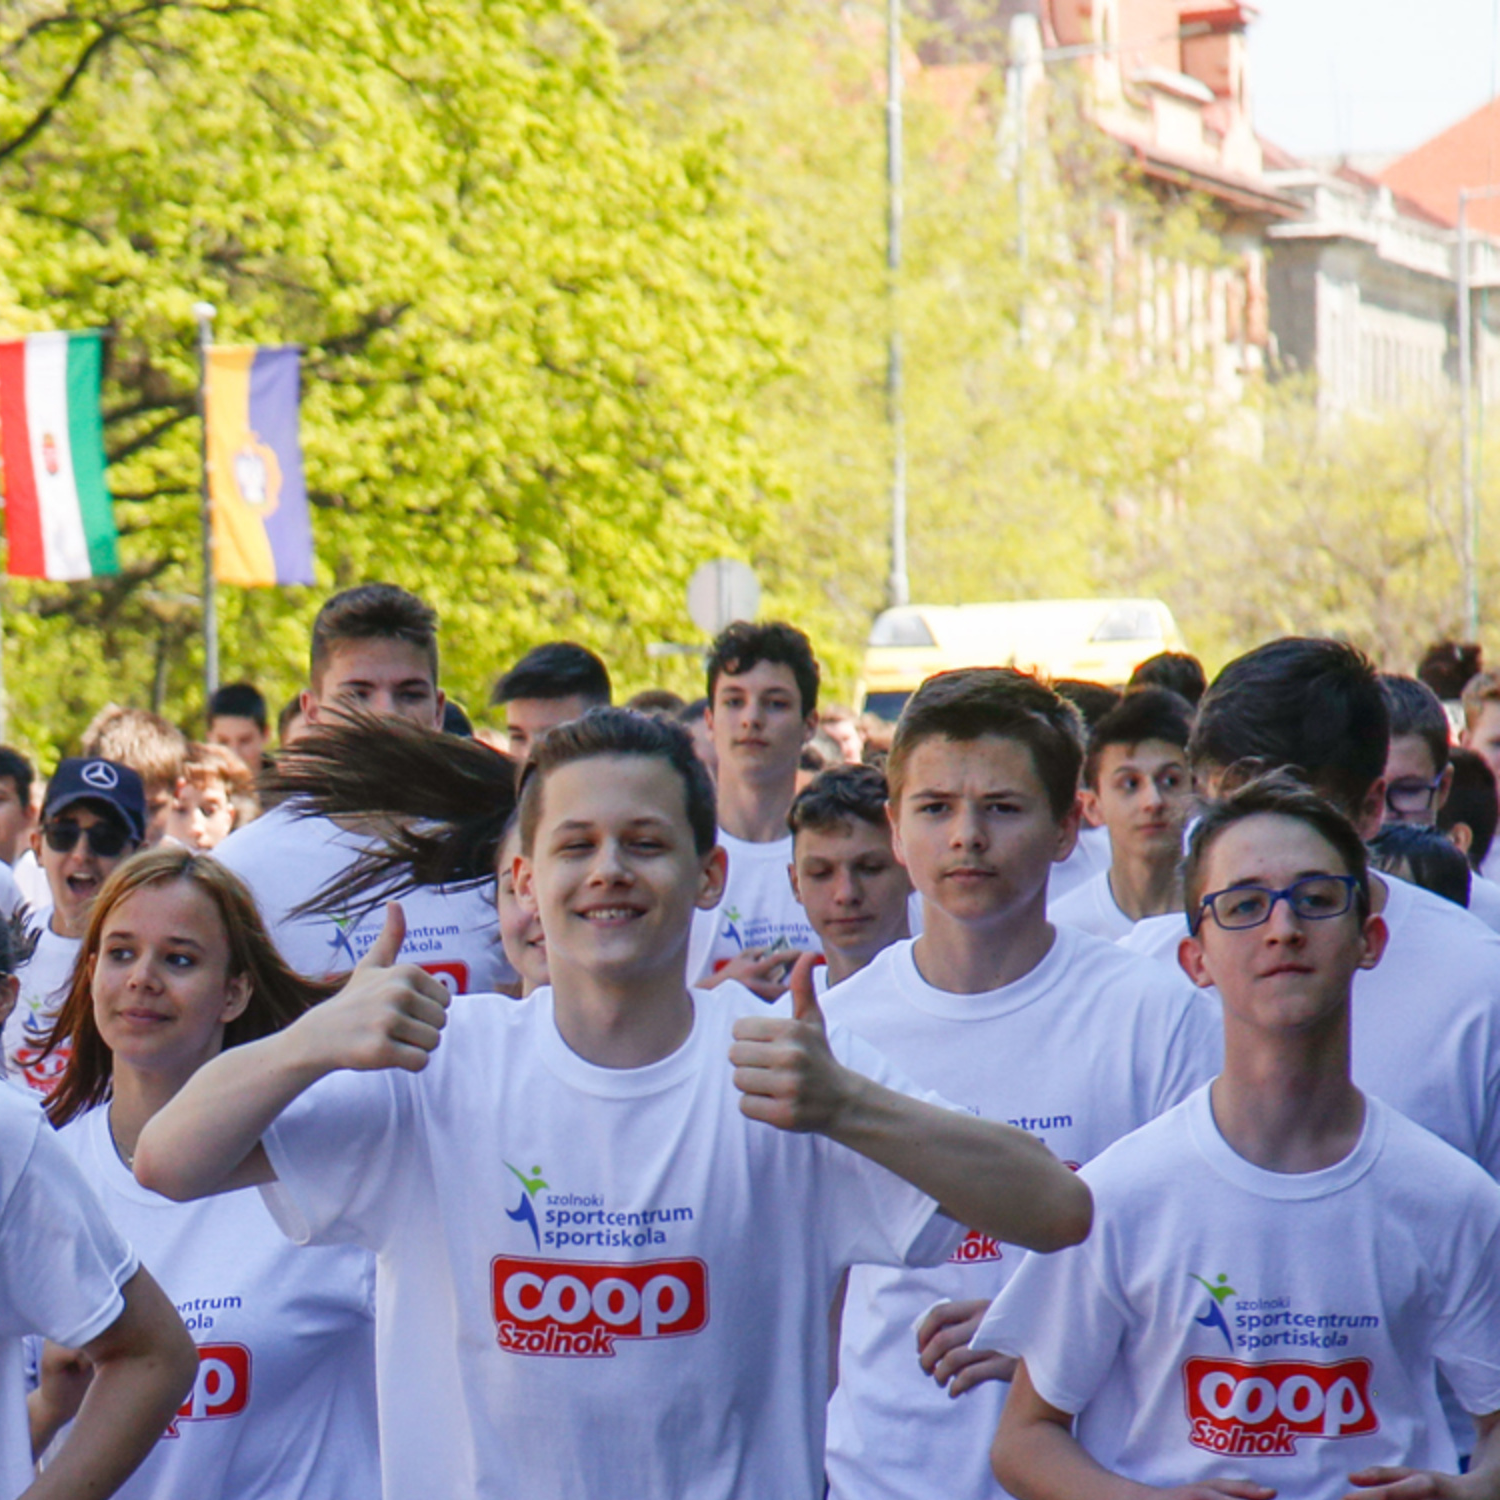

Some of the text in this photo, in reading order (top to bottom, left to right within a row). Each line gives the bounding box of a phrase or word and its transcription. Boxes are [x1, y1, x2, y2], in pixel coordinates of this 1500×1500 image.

[546, 1193, 604, 1208] szolnoki
[545, 1206, 694, 1228] sportcentrum
[543, 1227, 667, 1249] sportiskola
[503, 1271, 690, 1336] coop
[1235, 1296, 1291, 1311] szolnoki
[1236, 1310, 1379, 1332] sportcentrum
[499, 1322, 614, 1355] Szolnok
[1236, 1328, 1349, 1351] sportiskola
[1199, 1371, 1366, 1436] coop
[1192, 1418, 1295, 1454] Szolnok
